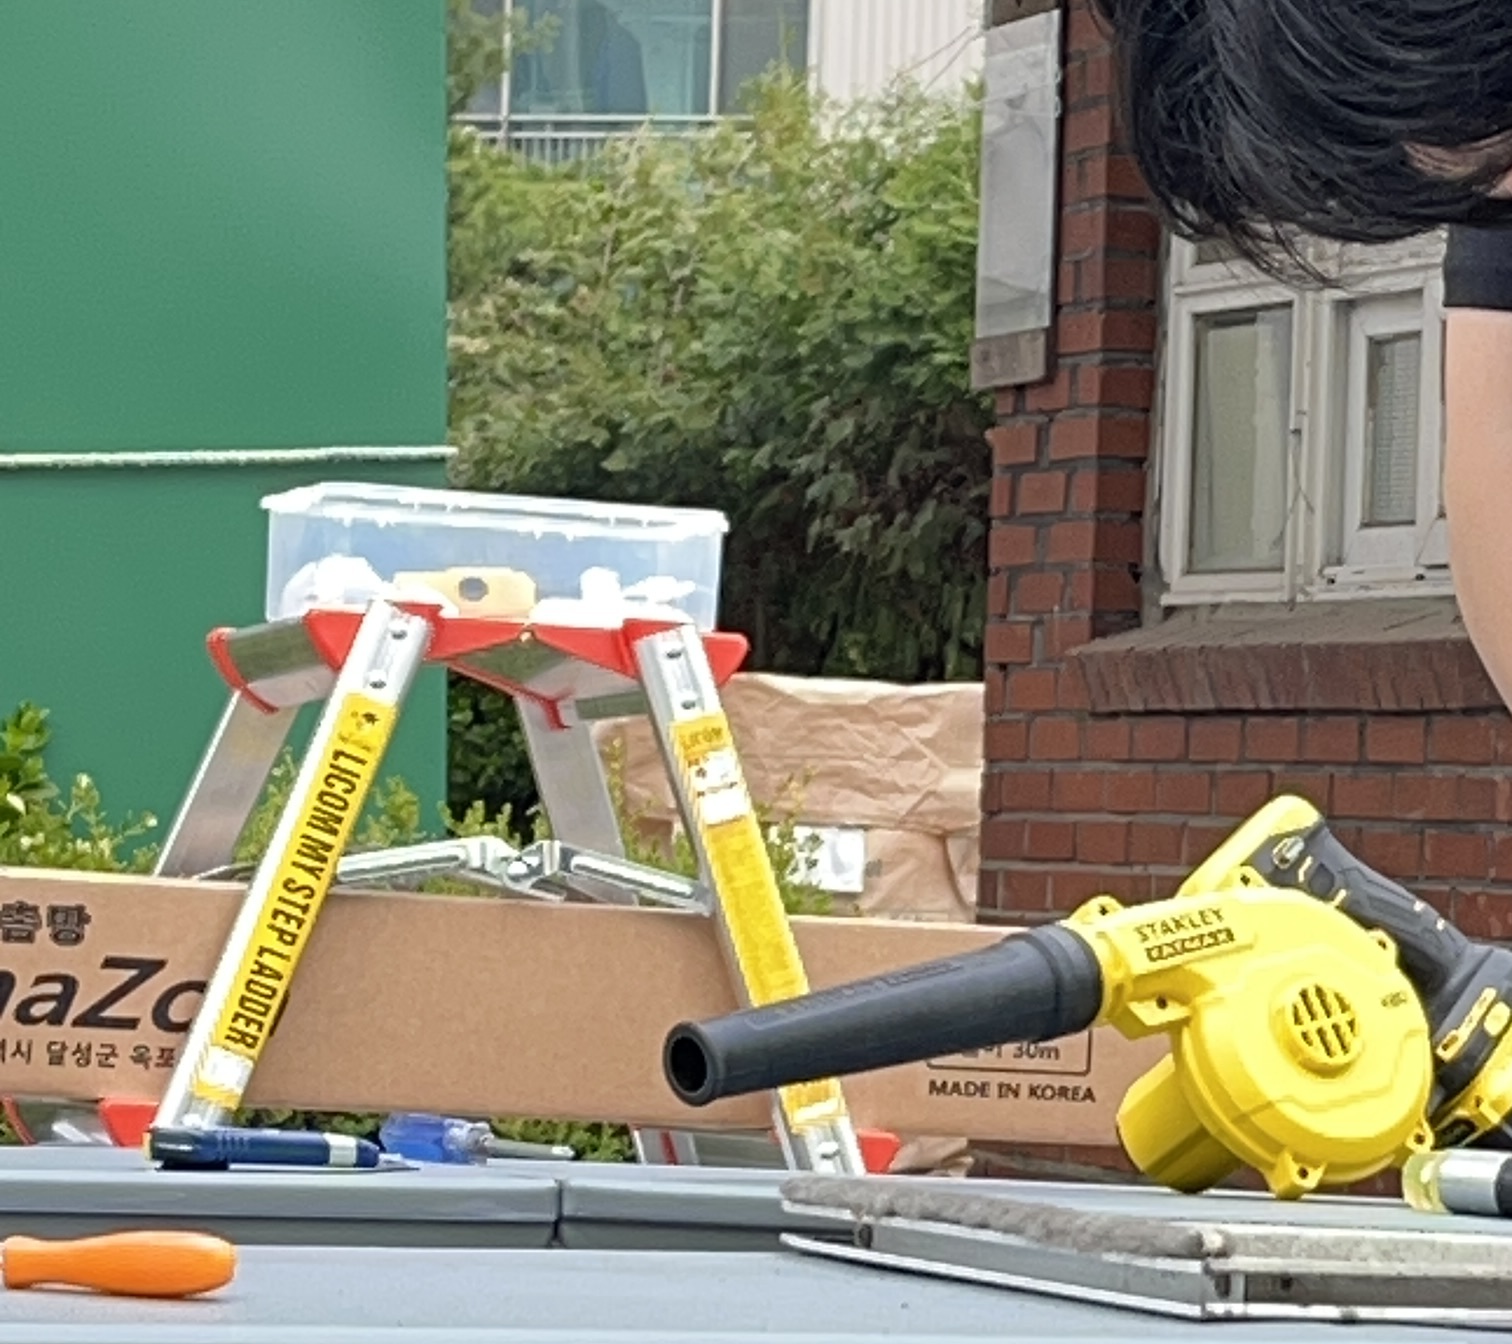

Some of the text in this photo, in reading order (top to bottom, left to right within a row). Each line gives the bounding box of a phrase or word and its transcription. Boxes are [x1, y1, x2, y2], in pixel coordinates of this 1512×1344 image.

[224, 749, 368, 1049] LICOM MY STEP LADDER
[1132, 907, 1225, 944] STANLEY
[46, 1040, 119, 1068] 달성군
[928, 1079, 1097, 1104] MADE IN KOREA
